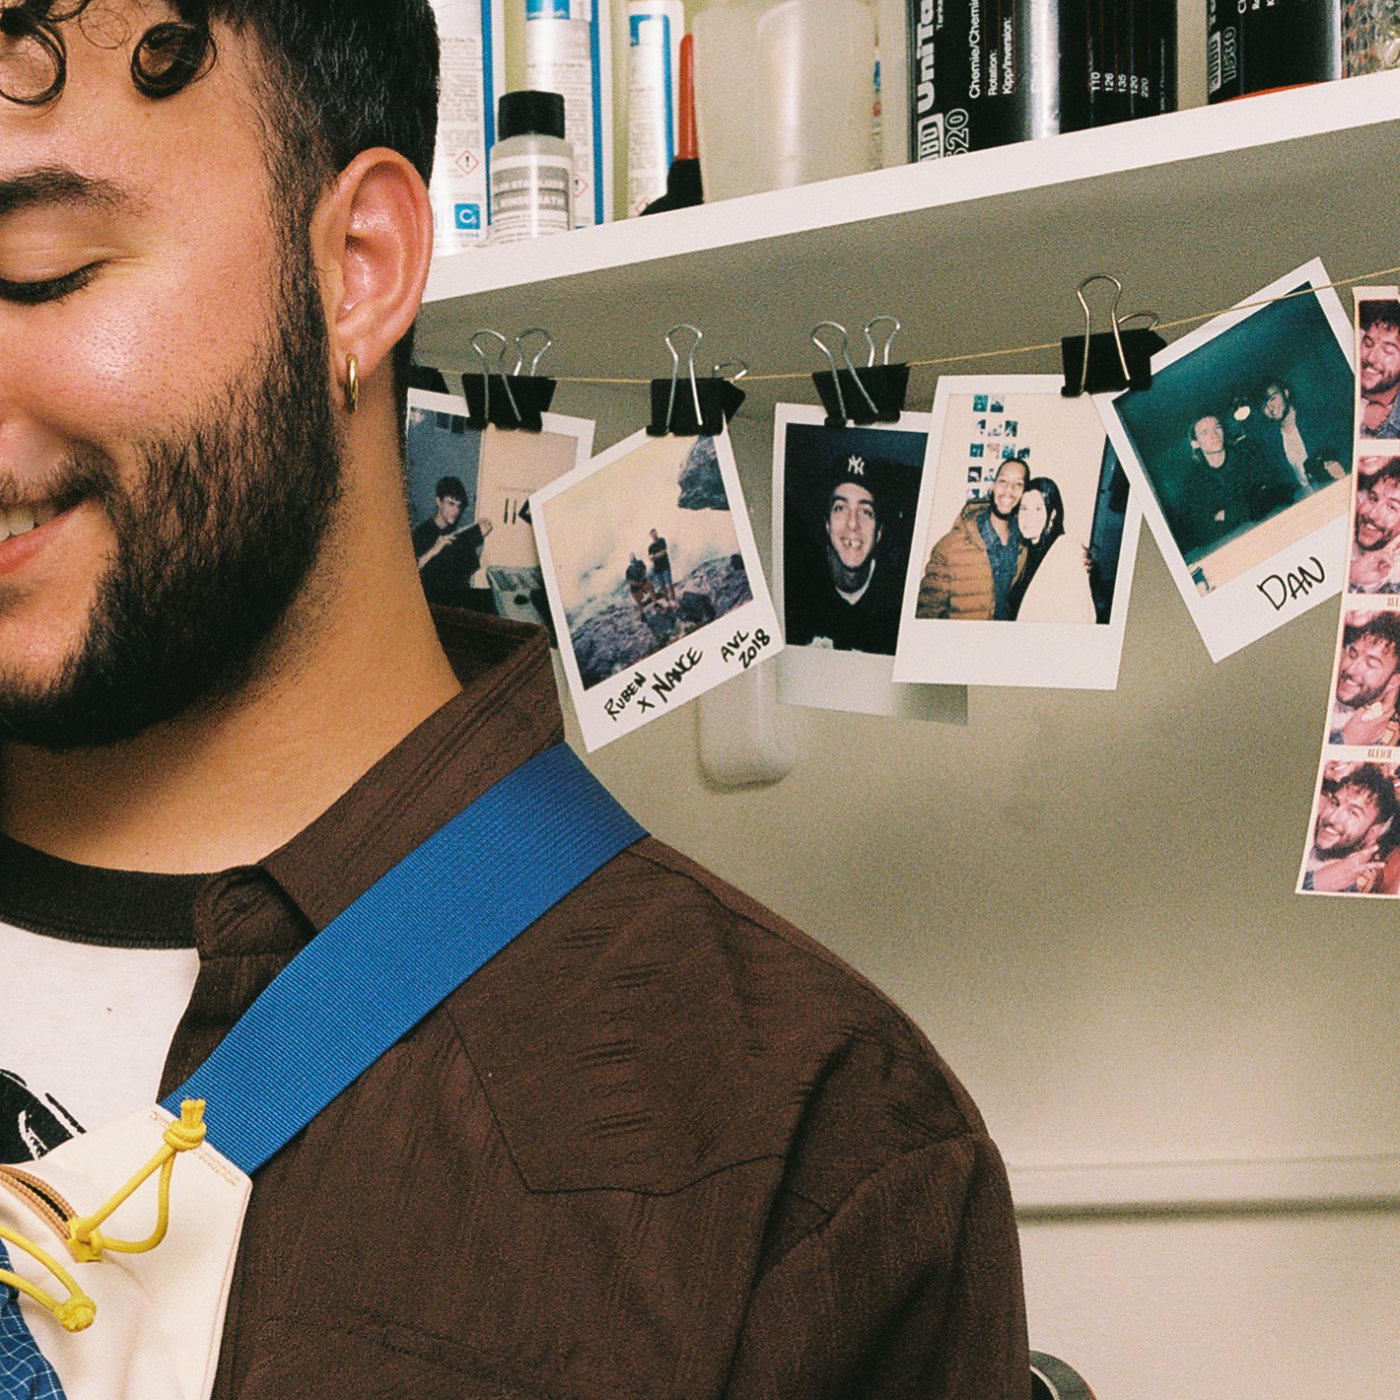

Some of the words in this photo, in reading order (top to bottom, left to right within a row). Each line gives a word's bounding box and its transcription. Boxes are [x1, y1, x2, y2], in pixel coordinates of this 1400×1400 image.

[987, 49, 998, 97] Rotation:
[1090, 71, 1101, 92] 110
[1104, 72, 1114, 92] 126
[1117, 74, 1127, 93] 135
[1130, 75, 1139, 95] 120
[1141, 77, 1149, 98] 220
[1256, 556, 1326, 612] DAN
[720, 630, 750, 663] AVL
[738, 628, 771, 669] 2018
[603, 671, 647, 722] RUBEN
